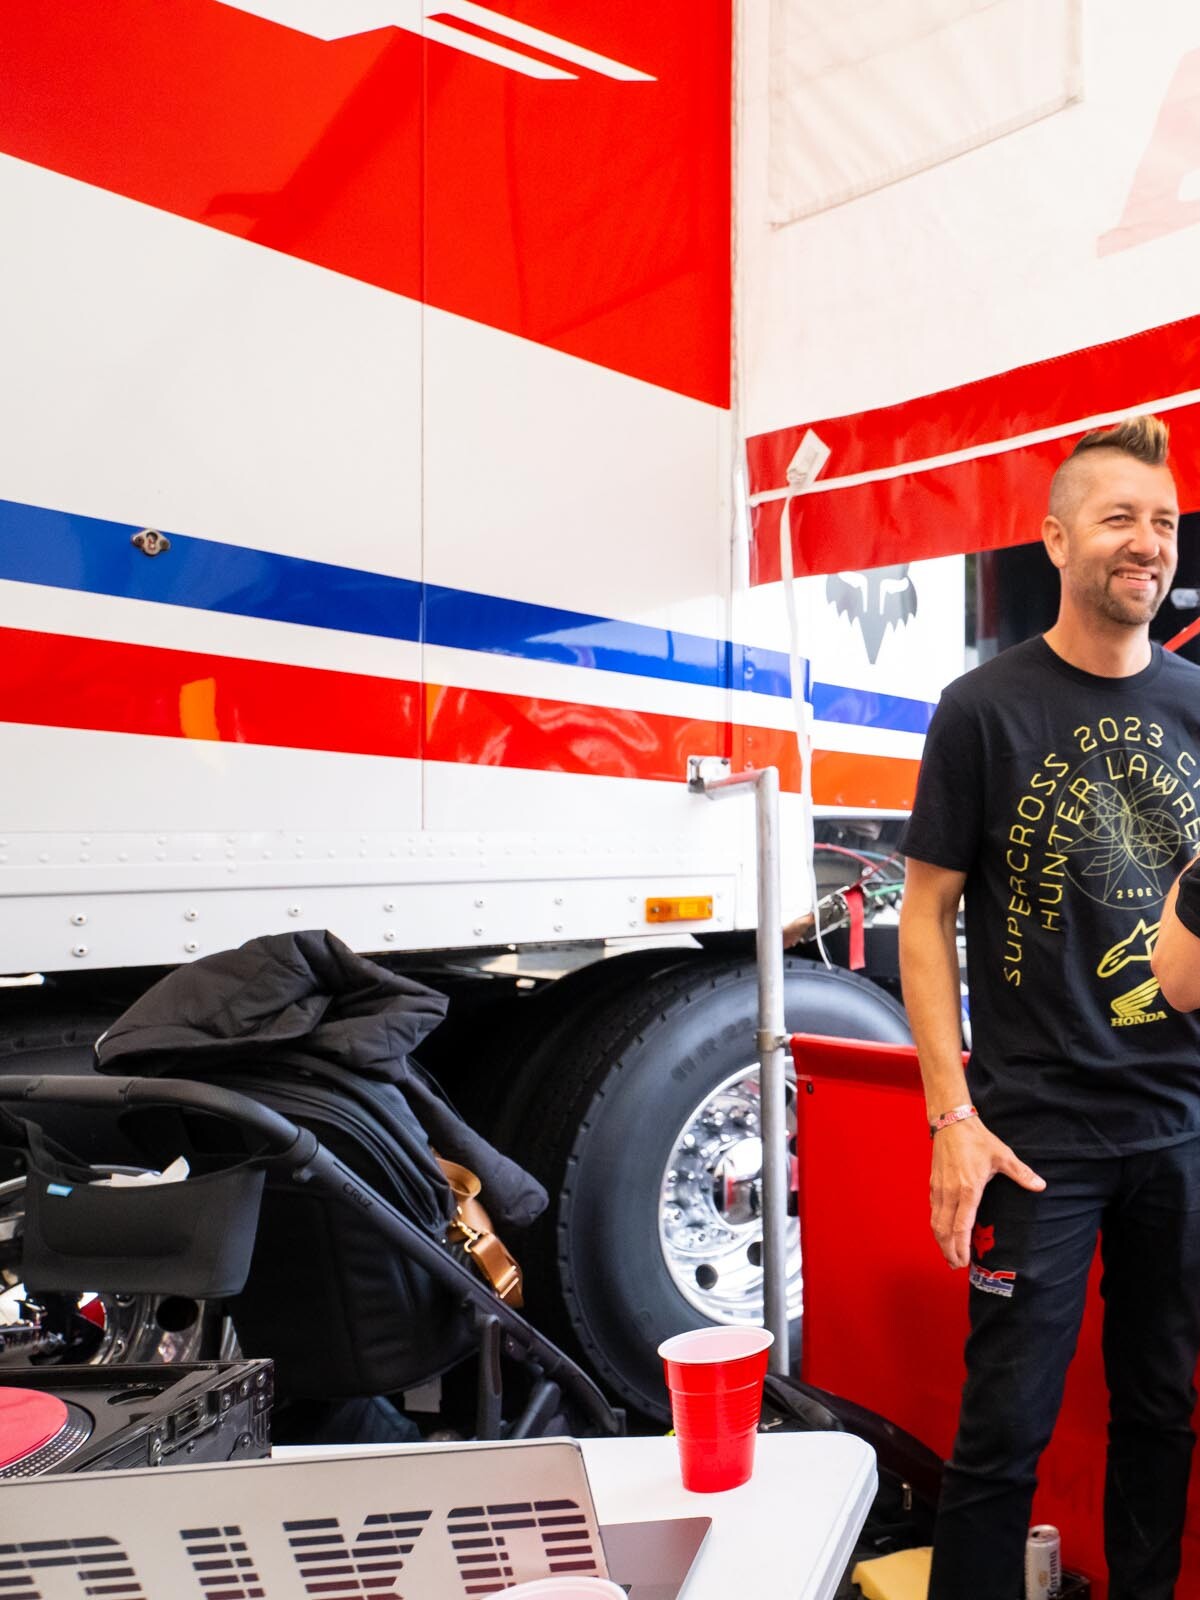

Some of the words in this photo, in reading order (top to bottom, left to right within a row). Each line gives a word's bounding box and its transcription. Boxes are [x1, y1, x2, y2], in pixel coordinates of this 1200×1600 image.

[1003, 753, 1069, 987] SUPERCROSS
[1073, 716, 1165, 752] 2023
[1039, 777, 1099, 931] HUNTER
[1111, 1010, 1168, 1027] HONDA
